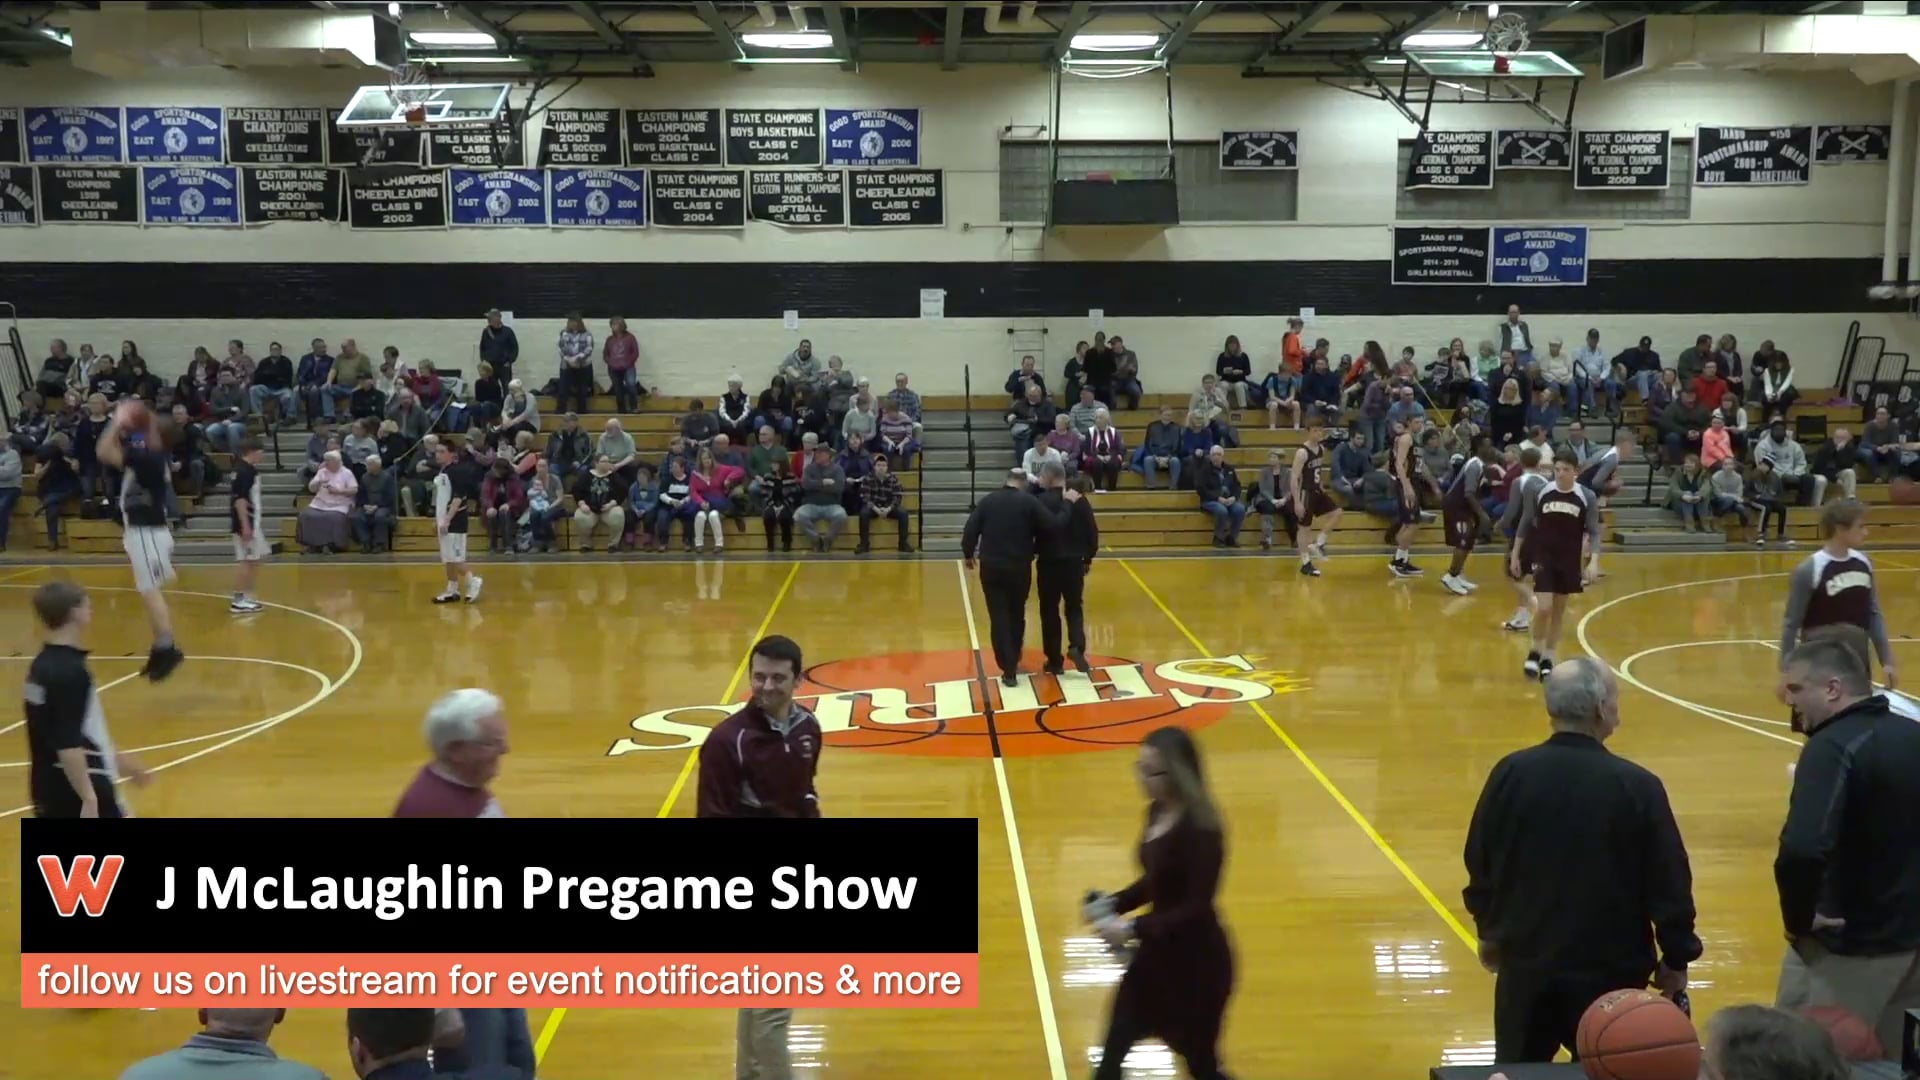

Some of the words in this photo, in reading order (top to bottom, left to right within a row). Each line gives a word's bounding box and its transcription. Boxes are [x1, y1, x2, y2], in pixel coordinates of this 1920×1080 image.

[228, 109, 281, 120] EASTERN
[284, 109, 320, 120] MAINE
[550, 111, 578, 121] STERN
[582, 111, 609, 121] MAINE
[637, 112, 679, 122] EASTERN
[682, 112, 708, 121] MAINE
[732, 113, 761, 123] STATE
[764, 113, 813, 123] CHAMPIONS
[161, 117, 187, 125] AWARD
[829, 116, 848, 132] GOOD
[852, 111, 914, 131] SPORTSMANSHIP
[860, 120, 886, 128] AWARD
[244, 122, 309, 134] CHAMPIONS
[556, 123, 605, 132] AMPIONS
[642, 123, 705, 133] CHAMPIONS
[730, 127, 753, 137] BOYS
[757, 127, 816, 137] BASKETBALL
[33, 136, 53, 145] EAST
[134, 136, 154, 145] EAST
[559, 134, 590, 142] 2003
[659, 134, 689, 142] 2004
[1437, 133, 1486, 143] CHAMPIONS
[1585, 133, 1611, 143] STATE
[1614, 133, 1662, 143] CHAMPIONS
[573, 144, 606, 152] SOCCER
[633, 143, 655, 152] BOYS
[659, 143, 716, 151] BASKETBALL
[749, 140, 786, 149] CLASS
[790, 140, 798, 149] C
[832, 139, 853, 148] EAST
[246, 144, 308, 153] CHEERLEADING
[452, 145, 490, 154] CLASS
[1432, 144, 1480, 154] CHAMPIONS
[1590, 145, 1606, 154] PVC
[1610, 145, 1656, 154] CHAMPIONS
[258, 154, 283, 162] CLASS
[552, 154, 589, 162] CLASS
[592, 154, 599, 162] C
[651, 153, 688, 161] CLASS
[692, 153, 699, 161] C
[758, 152, 789, 160] 2004
[1452, 155, 1486, 164] CHAMPIONS
[1699, 141, 1769, 169] SPORTSMANSHIP
[1780, 144, 1808, 168] AWARD
[461, 156, 492, 164] 2002
[1629, 155, 1662, 165] CHAMPIONS
[56, 170, 94, 178] EASTERN
[96, 170, 121, 178] MAINE
[1416, 166, 1442, 174] CLASS
[1445, 166, 1450, 174] C
[1454, 166, 1477, 174] GOLF
[1592, 166, 1620, 174] CLASS
[1622, 166, 1628, 174] C
[1631, 166, 1653, 174] GOLF
[256, 170, 297, 180] EASTERN
[300, 170, 328, 180] MAINE
[657, 175, 684, 184] STATE
[689, 175, 738, 184] CHAMPIONS
[753, 173, 780, 183] STATE
[784, 173, 840, 183] RUNNERS-UP
[856, 175, 885, 184] STATE
[889, 174, 934, 184] CHAMPIONS
[1704, 171, 1725, 182] BOYS
[1750, 171, 1802, 182] BASKETBALL
[383, 174, 442, 186] CHAMPIONS
[455, 177, 474, 193] GOOD
[478, 171, 542, 192] SPORTSMANSHIP
[485, 180, 511, 188] AWARD
[555, 176, 575, 192] GOOD
[578, 171, 640, 192] SPORTSMANSHIP
[585, 180, 612, 188] AWARD
[67, 181, 111, 189] CHAMPIONS
[259, 182, 324, 191] CHAMPIONS
[753, 184, 780, 194] EASTERN
[784, 184, 803, 194] MAINE
[355, 188, 438, 199] CHEERLEADING
[656, 188, 741, 198] CHEERLEADING
[856, 187, 936, 198] CHEERLEADING
[151, 196, 171, 205] EAST
[518, 199, 539, 207] 2002
[557, 199, 578, 208] EAST
[617, 200, 637, 208] 2004
[781, 195, 812, 204] 2004
[61, 201, 118, 210] CHEERLEADING
[260, 202, 324, 210] CHEERLEADING
[372, 202, 410, 211] CLASS
[673, 201, 711, 210] CLASS
[715, 201, 723, 210] C
[768, 205, 827, 213] SOFTBALL
[872, 201, 908, 210] CLASS
[912, 201, 920, 209] C
[383, 215, 413, 223] 2002
[683, 213, 714, 221] 2004
[814, 214, 821, 222] C
[1524, 240, 1556, 248] AWARD
[1399, 246, 1457, 256] SPORTSMANSHIP
[1459, 247, 1484, 257] AWARD
[1495, 258, 1519, 266] EAST
[1521, 258, 1528, 266] D
[1561, 258, 1583, 266] 2014
